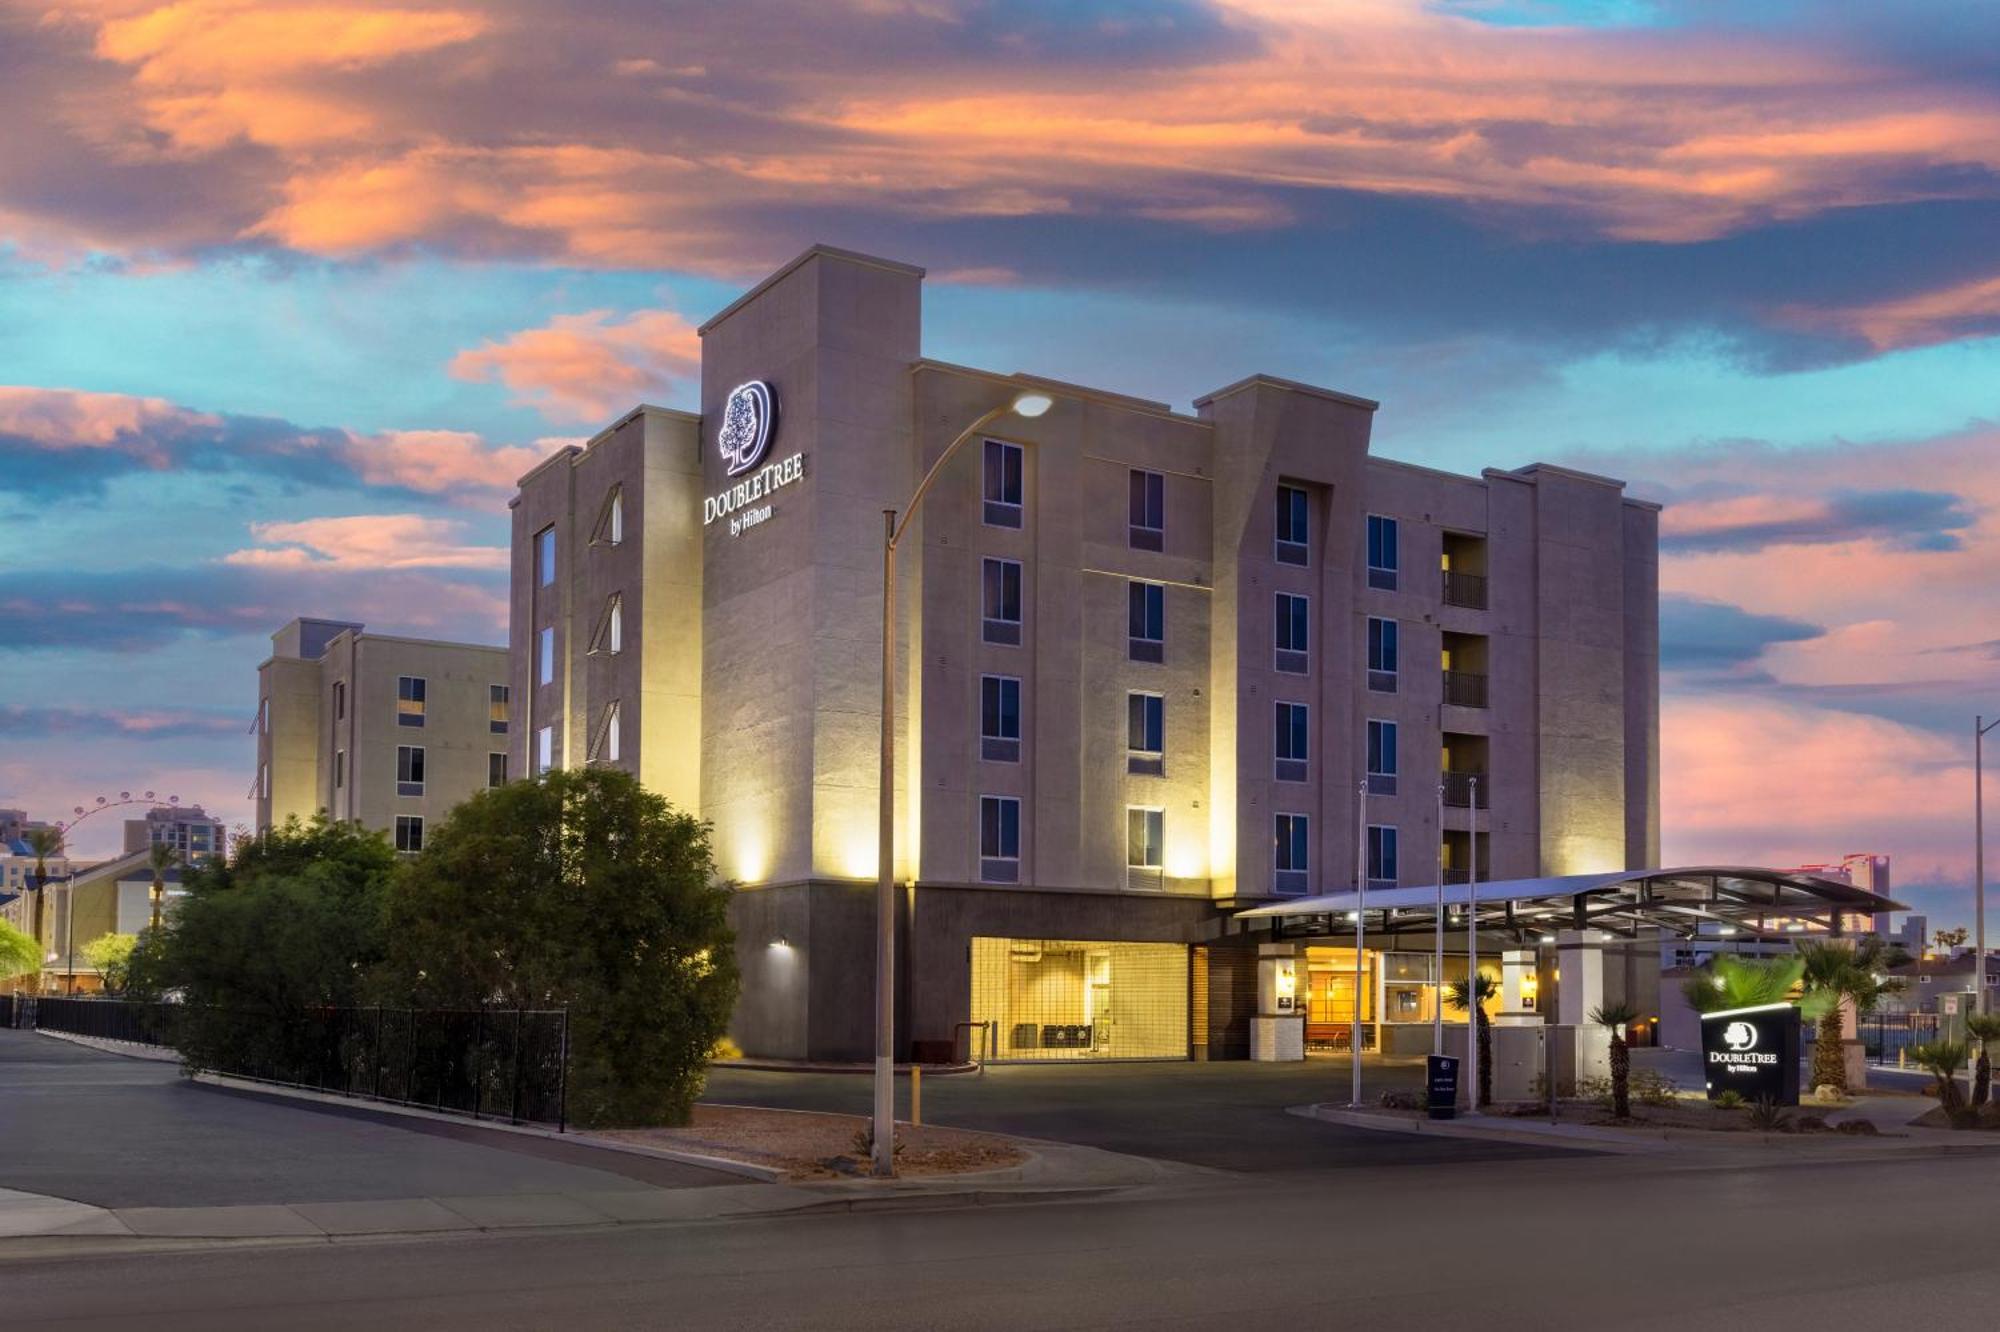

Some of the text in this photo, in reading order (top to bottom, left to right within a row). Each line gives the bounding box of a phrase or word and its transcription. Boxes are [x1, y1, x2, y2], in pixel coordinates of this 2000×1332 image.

[731, 505, 772, 537] by Hilton
[1727, 1064, 1757, 1074] by Hilton
